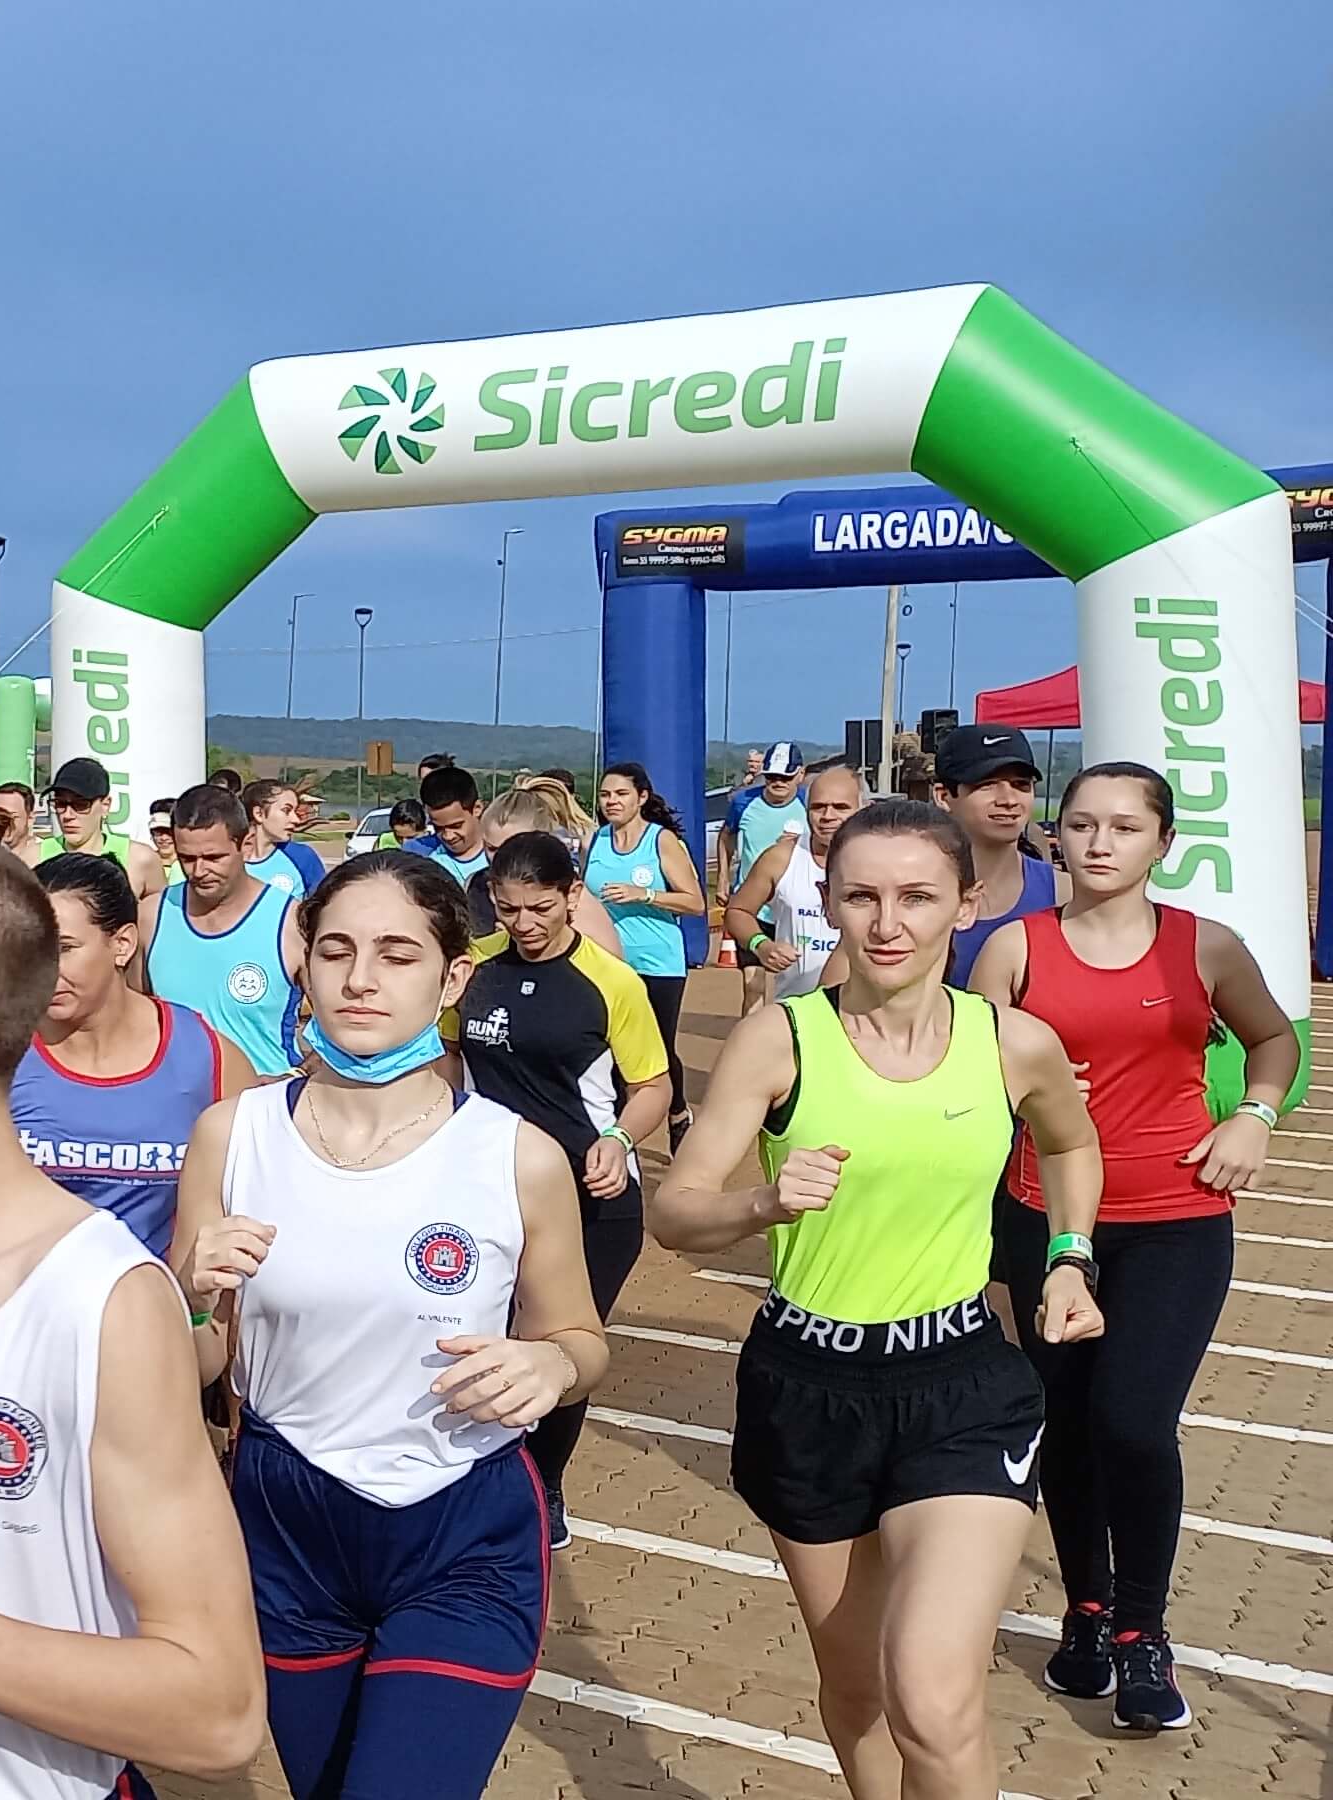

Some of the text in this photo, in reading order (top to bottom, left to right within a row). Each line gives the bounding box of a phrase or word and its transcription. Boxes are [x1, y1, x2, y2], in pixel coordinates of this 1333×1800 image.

[473, 337, 848, 452] Sicredi
[622, 526, 728, 545] SYGMA
[775, 1302, 865, 1353] PRO
[884, 1291, 984, 1354] NIKE
